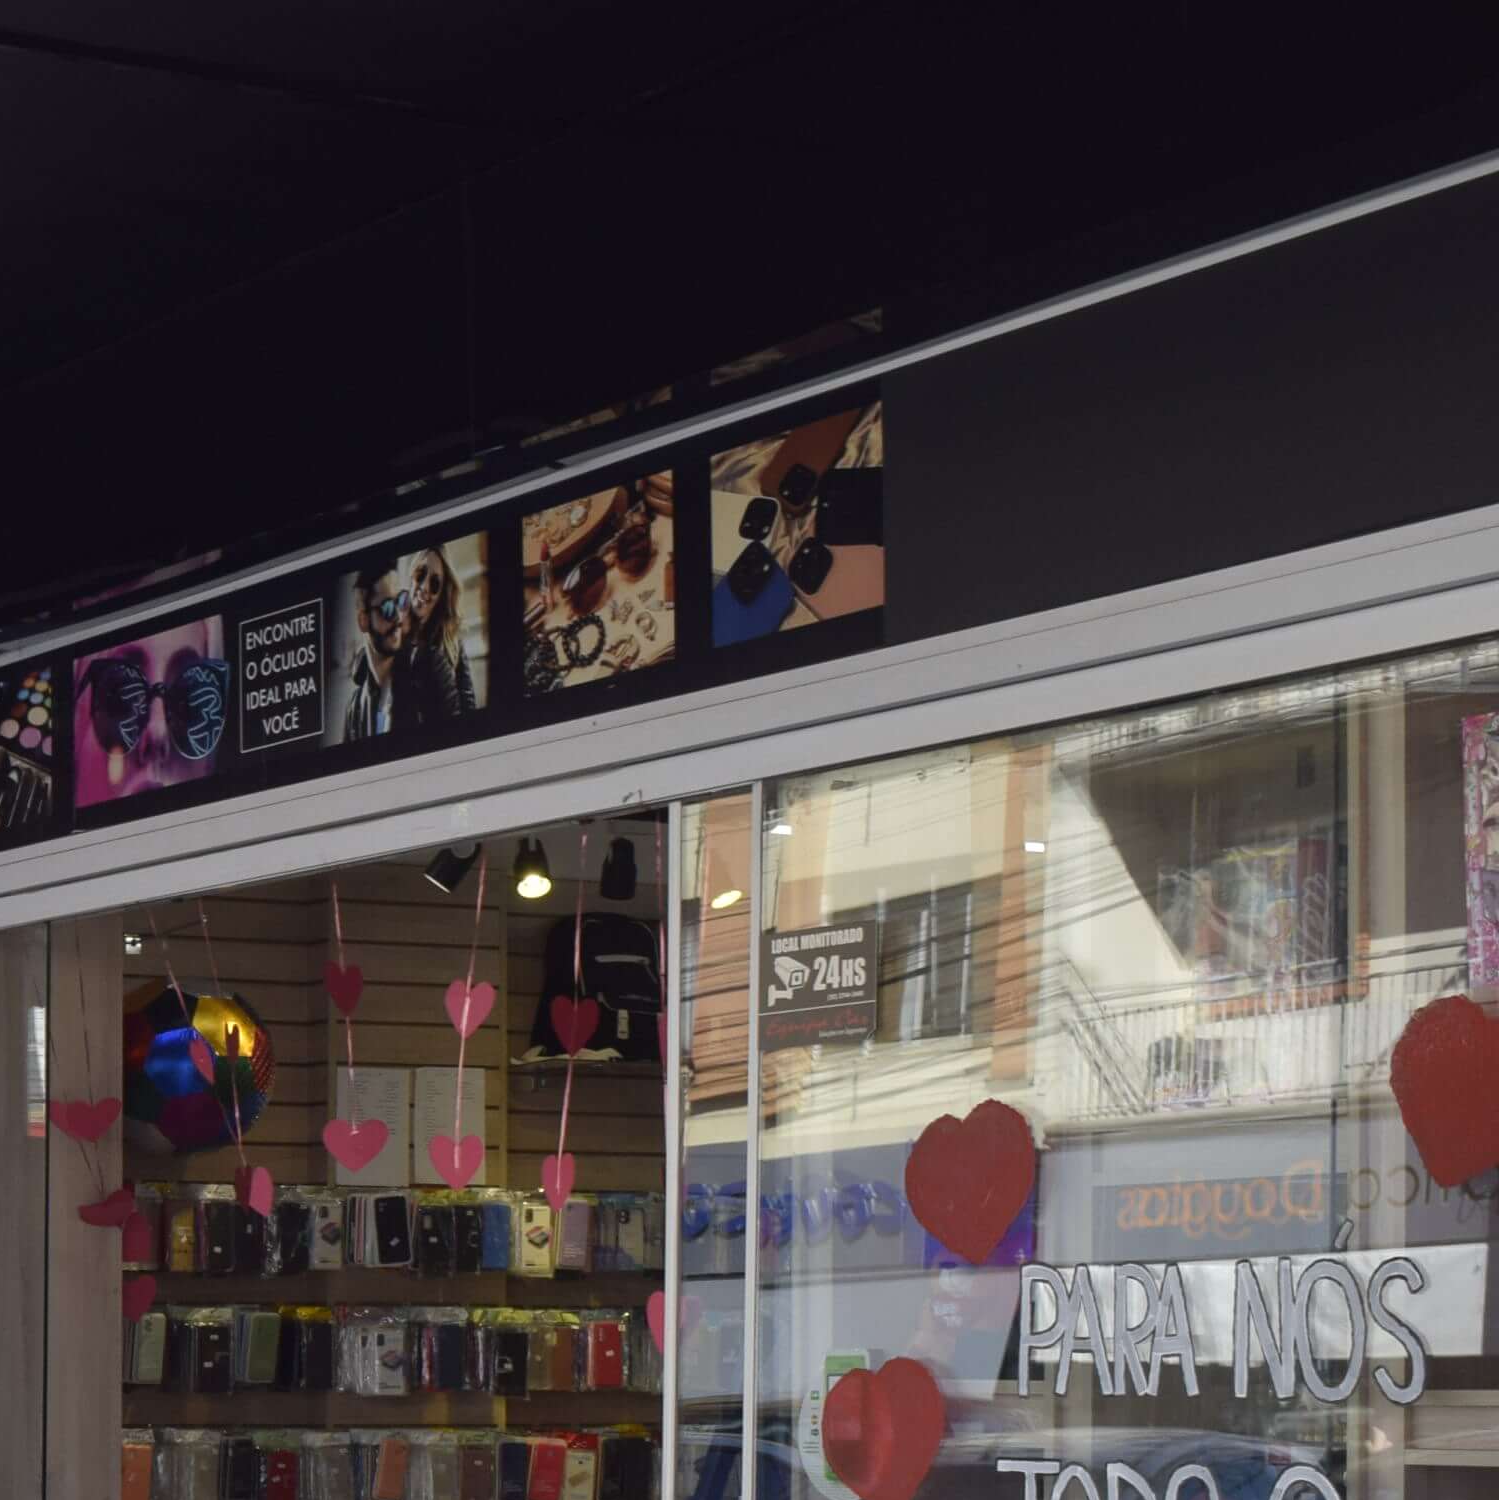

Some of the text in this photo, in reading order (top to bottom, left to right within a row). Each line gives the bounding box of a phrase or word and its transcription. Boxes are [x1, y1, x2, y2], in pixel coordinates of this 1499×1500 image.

[245, 613, 316, 651] ENCONTRE
[246, 644, 316, 681] O ÓCULOS
[246, 676, 317, 711] IDEAL PARA
[770, 927, 864, 955] LOCAL MONITORADO
[812, 954, 867, 991] 24HS
[1017, 1217, 1429, 1405] PARA NÓS
